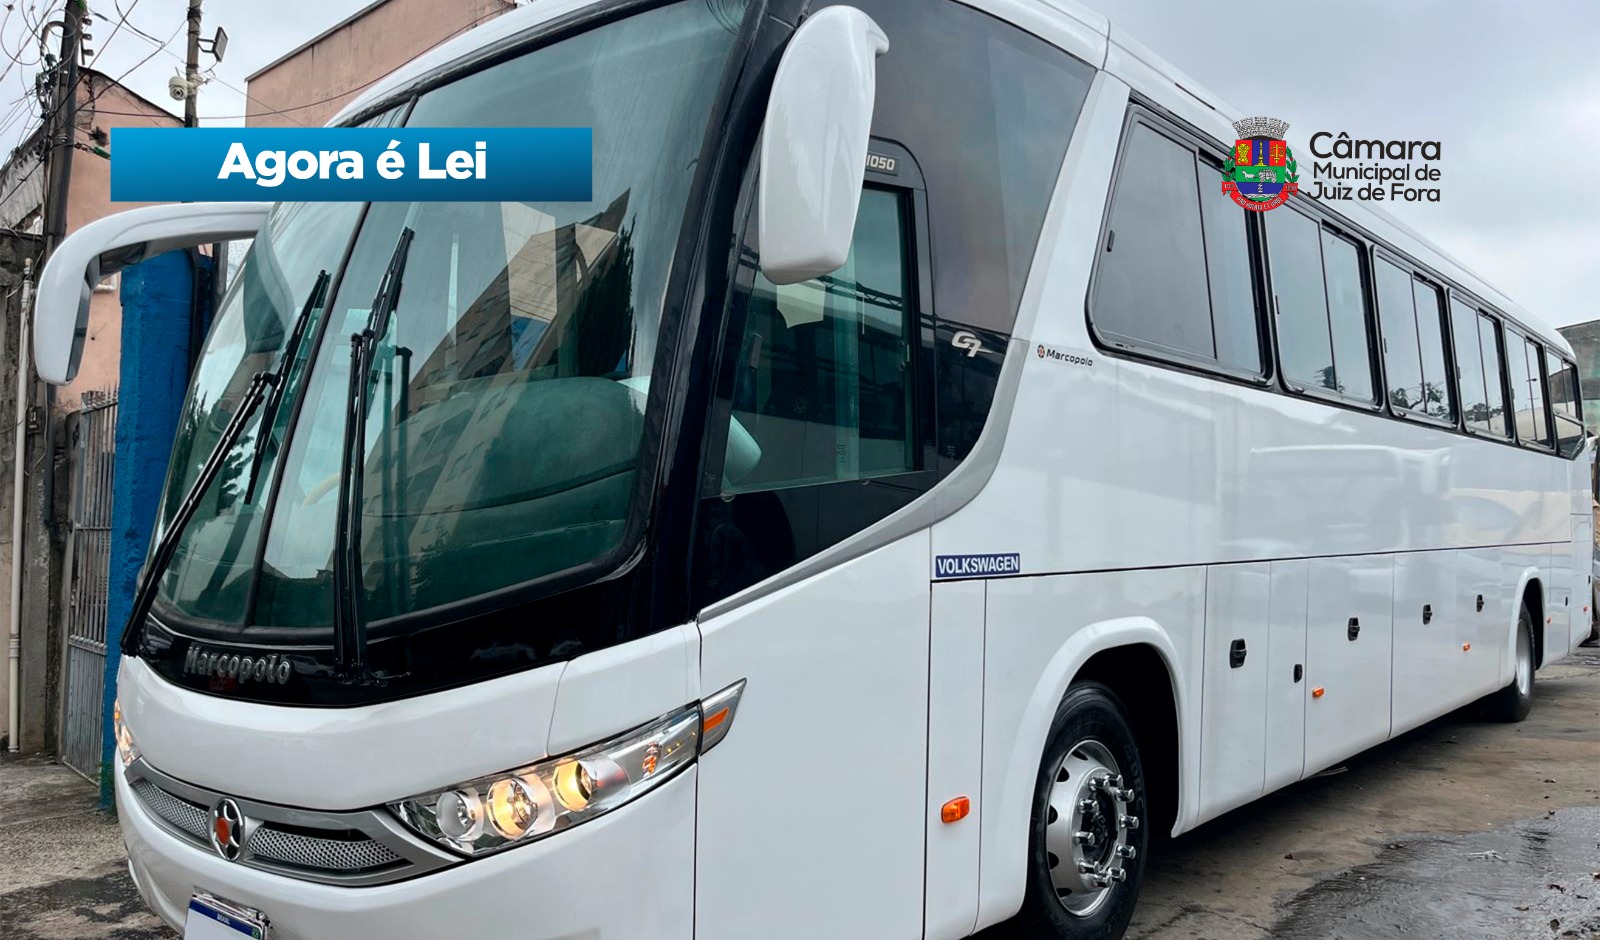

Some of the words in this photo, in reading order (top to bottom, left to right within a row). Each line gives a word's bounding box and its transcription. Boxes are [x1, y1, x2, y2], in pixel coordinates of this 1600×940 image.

[1046, 348, 1094, 367] Marcopolo
[937, 556, 1019, 575] VOLKSWAGEN
[183, 644, 292, 685] Marcopolo
